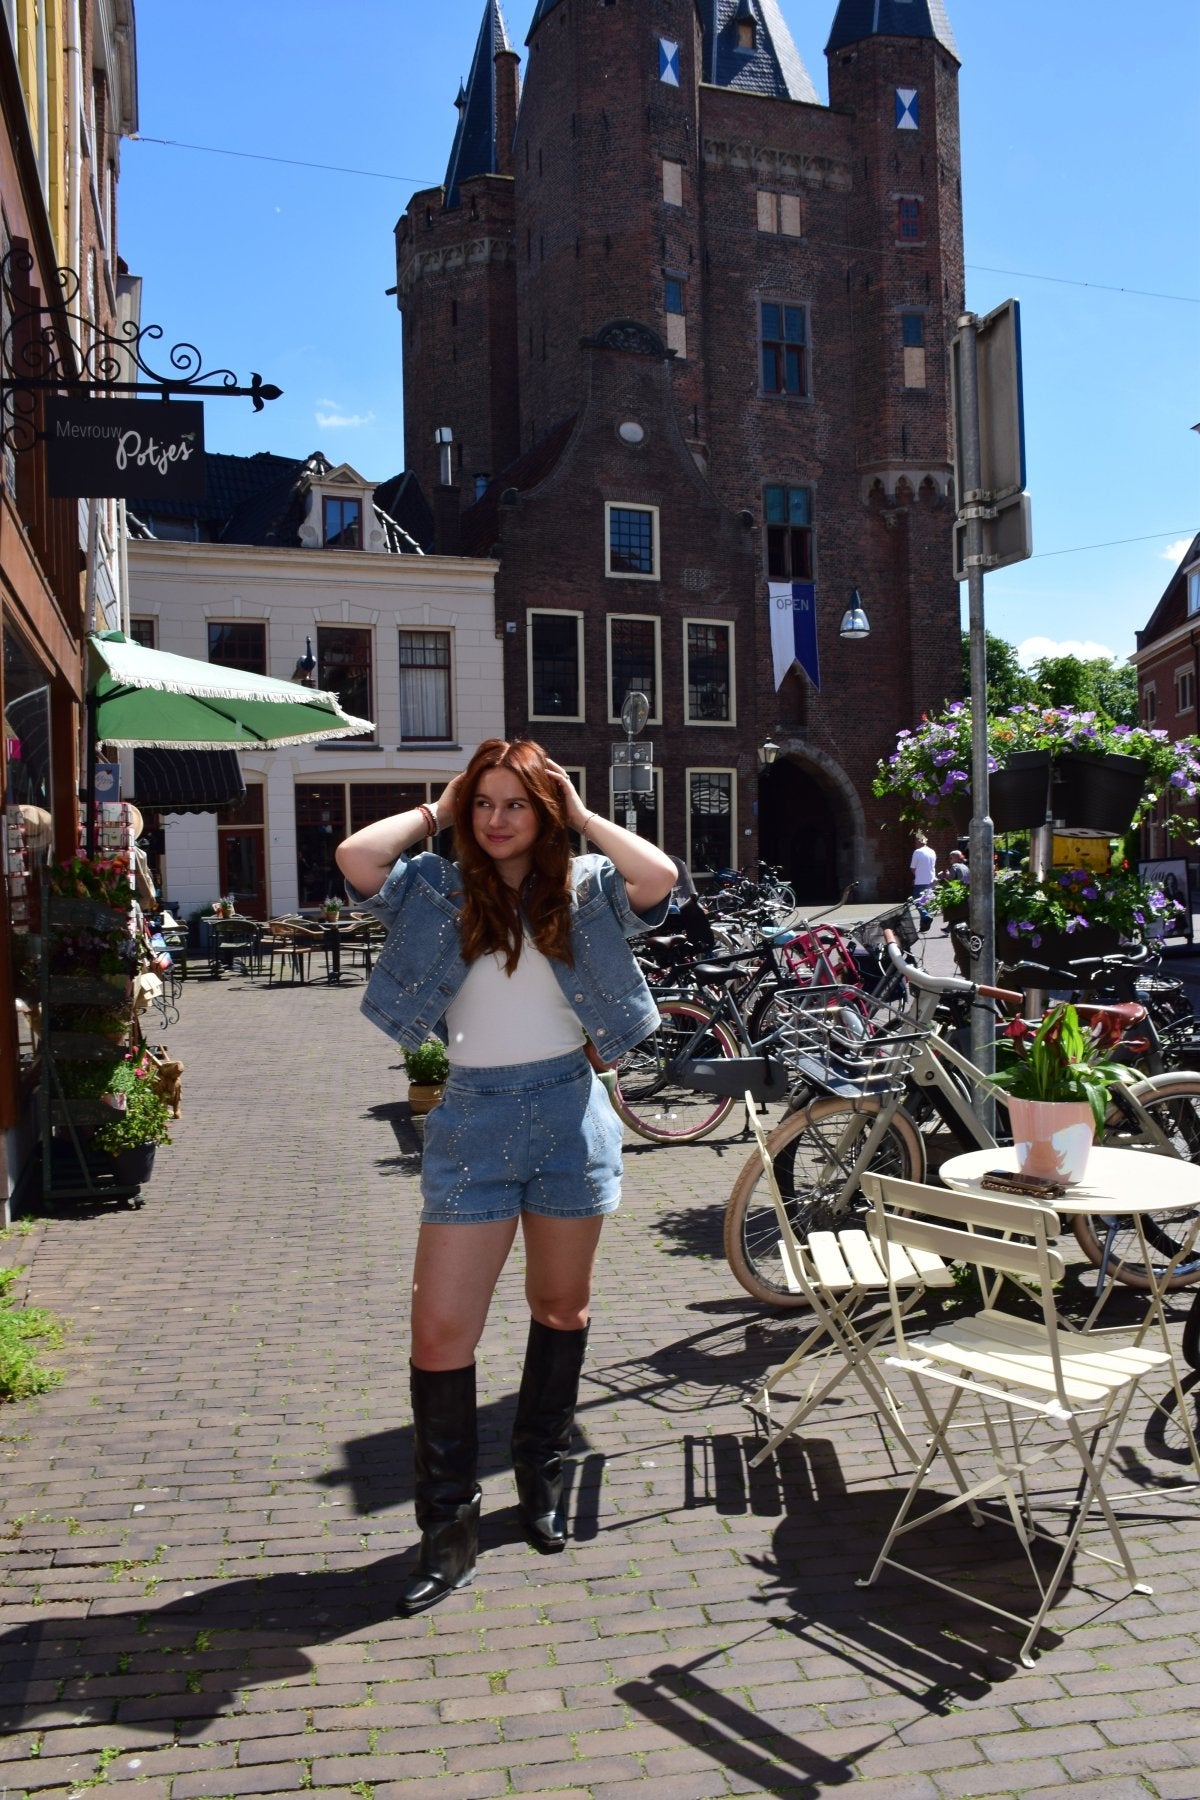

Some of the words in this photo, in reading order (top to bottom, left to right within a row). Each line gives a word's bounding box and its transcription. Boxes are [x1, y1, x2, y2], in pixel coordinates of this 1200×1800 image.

[56, 420, 122, 439] Mevrouw
[116, 430, 194, 475] Potjes
[776, 598, 809, 611] OPEN
